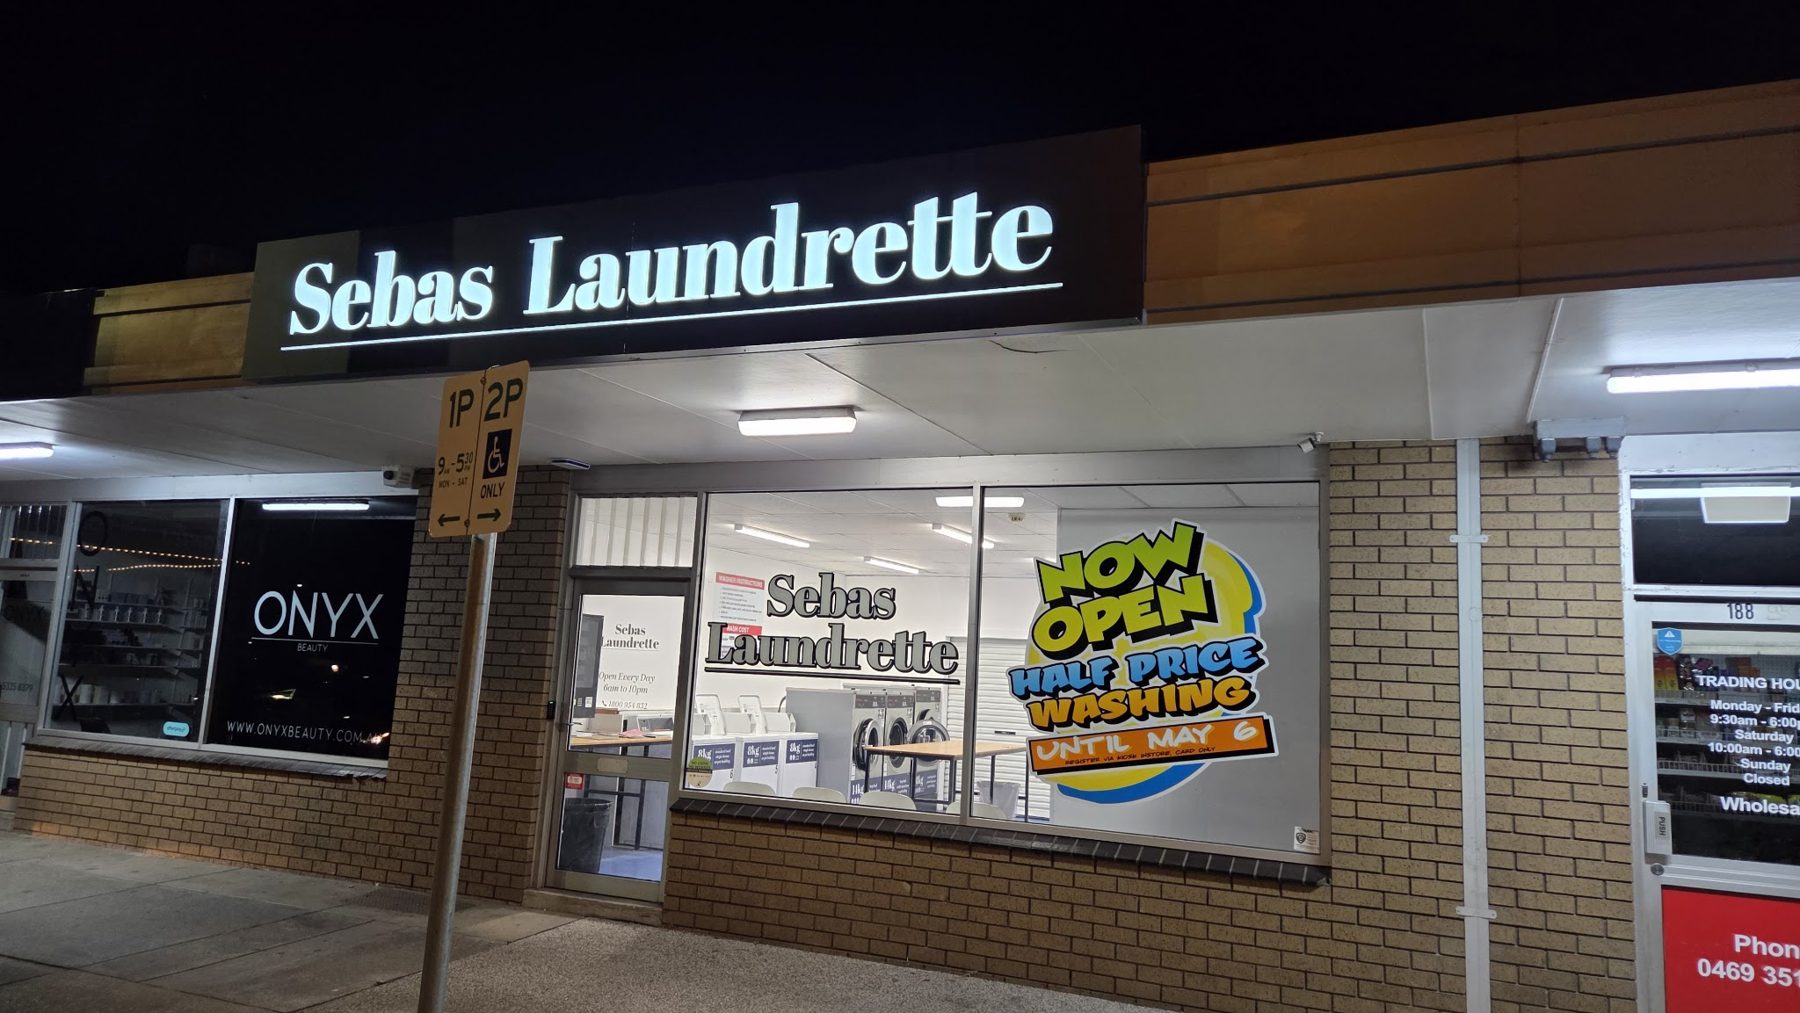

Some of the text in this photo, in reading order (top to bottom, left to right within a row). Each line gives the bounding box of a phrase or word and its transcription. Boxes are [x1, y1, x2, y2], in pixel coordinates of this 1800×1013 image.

[289, 192, 1053, 336] Sebas Laundrette
[484, 378, 524, 421] 2P
[449, 388, 474, 428] 1P
[480, 482, 505, 499] ONLY
[1036, 521, 1204, 603] NOW
[766, 572, 896, 620] Sebas
[254, 590, 384, 640] ONYX
[1032, 573, 1217, 661] OPEN
[1727, 603, 1754, 619] 188
[615, 624, 646, 635] Sebas
[296, 643, 328, 652] BEAUTY
[704, 622, 959, 674] Laundrette
[1009, 636, 1266, 700] HALF PRICE
[599, 671, 656, 684] Open Every Day
[1695, 675, 1767, 688] TRADING
[603, 684, 619, 692] 6am
[629, 685, 648, 695] 10pm
[1026, 676, 1258, 731] WASHING
[1710, 700, 1763, 714] Monday
[1710, 714, 1758, 726] 9:30am
[1037, 720, 1258, 760] UNTIL MAY 6
[1735, 729, 1794, 744] Saturday
[747, 745, 760, 757] 8kg
[789, 742, 801, 754] 8kg
[1708, 743, 1763, 755] 10:00am
[1065, 757, 1100, 765] REGISTER
[1740, 758, 1791, 773] Sunday
[1743, 773, 1790, 786] Closed
[1658, 816, 1667, 836] PUSH
[1697, 957, 1755, 982] 0469
